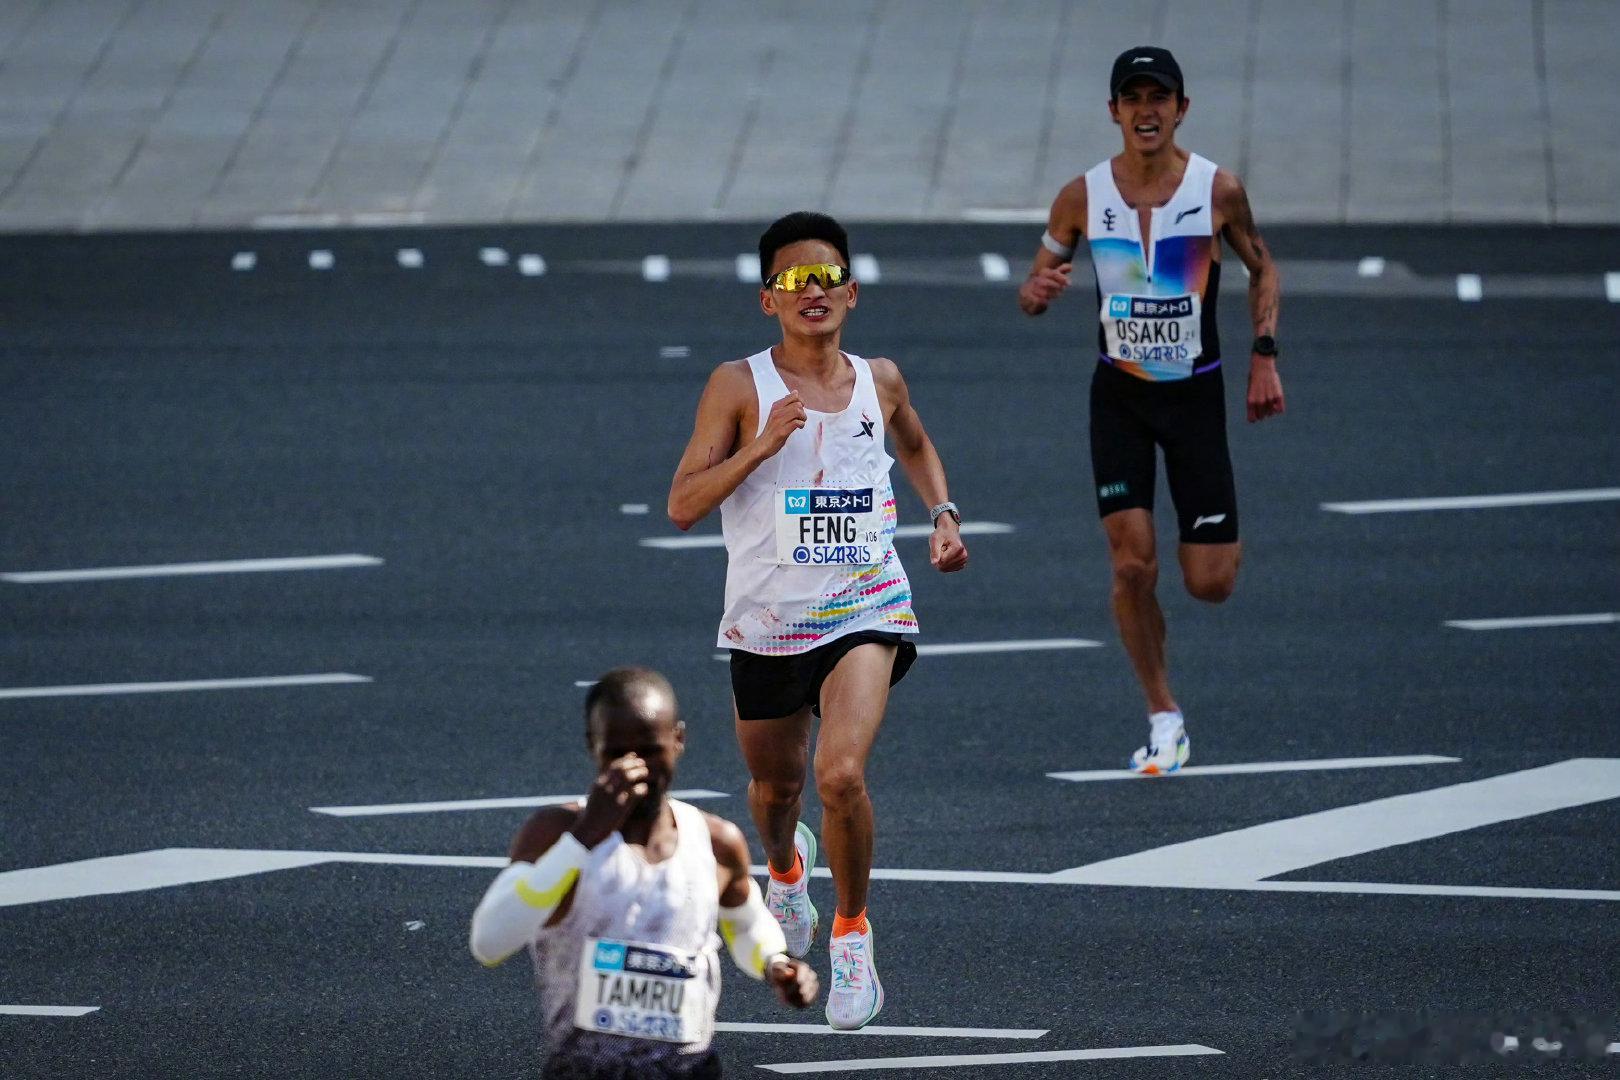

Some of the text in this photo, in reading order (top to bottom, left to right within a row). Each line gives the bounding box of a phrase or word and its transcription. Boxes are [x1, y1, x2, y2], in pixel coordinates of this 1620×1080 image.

[1115, 319, 1180, 343] OSAKO
[814, 495, 871, 508] 東京メトロ
[799, 515, 857, 544] FENG
[865, 531, 878, 543] 106
[598, 973, 685, 1014] TAMRU
